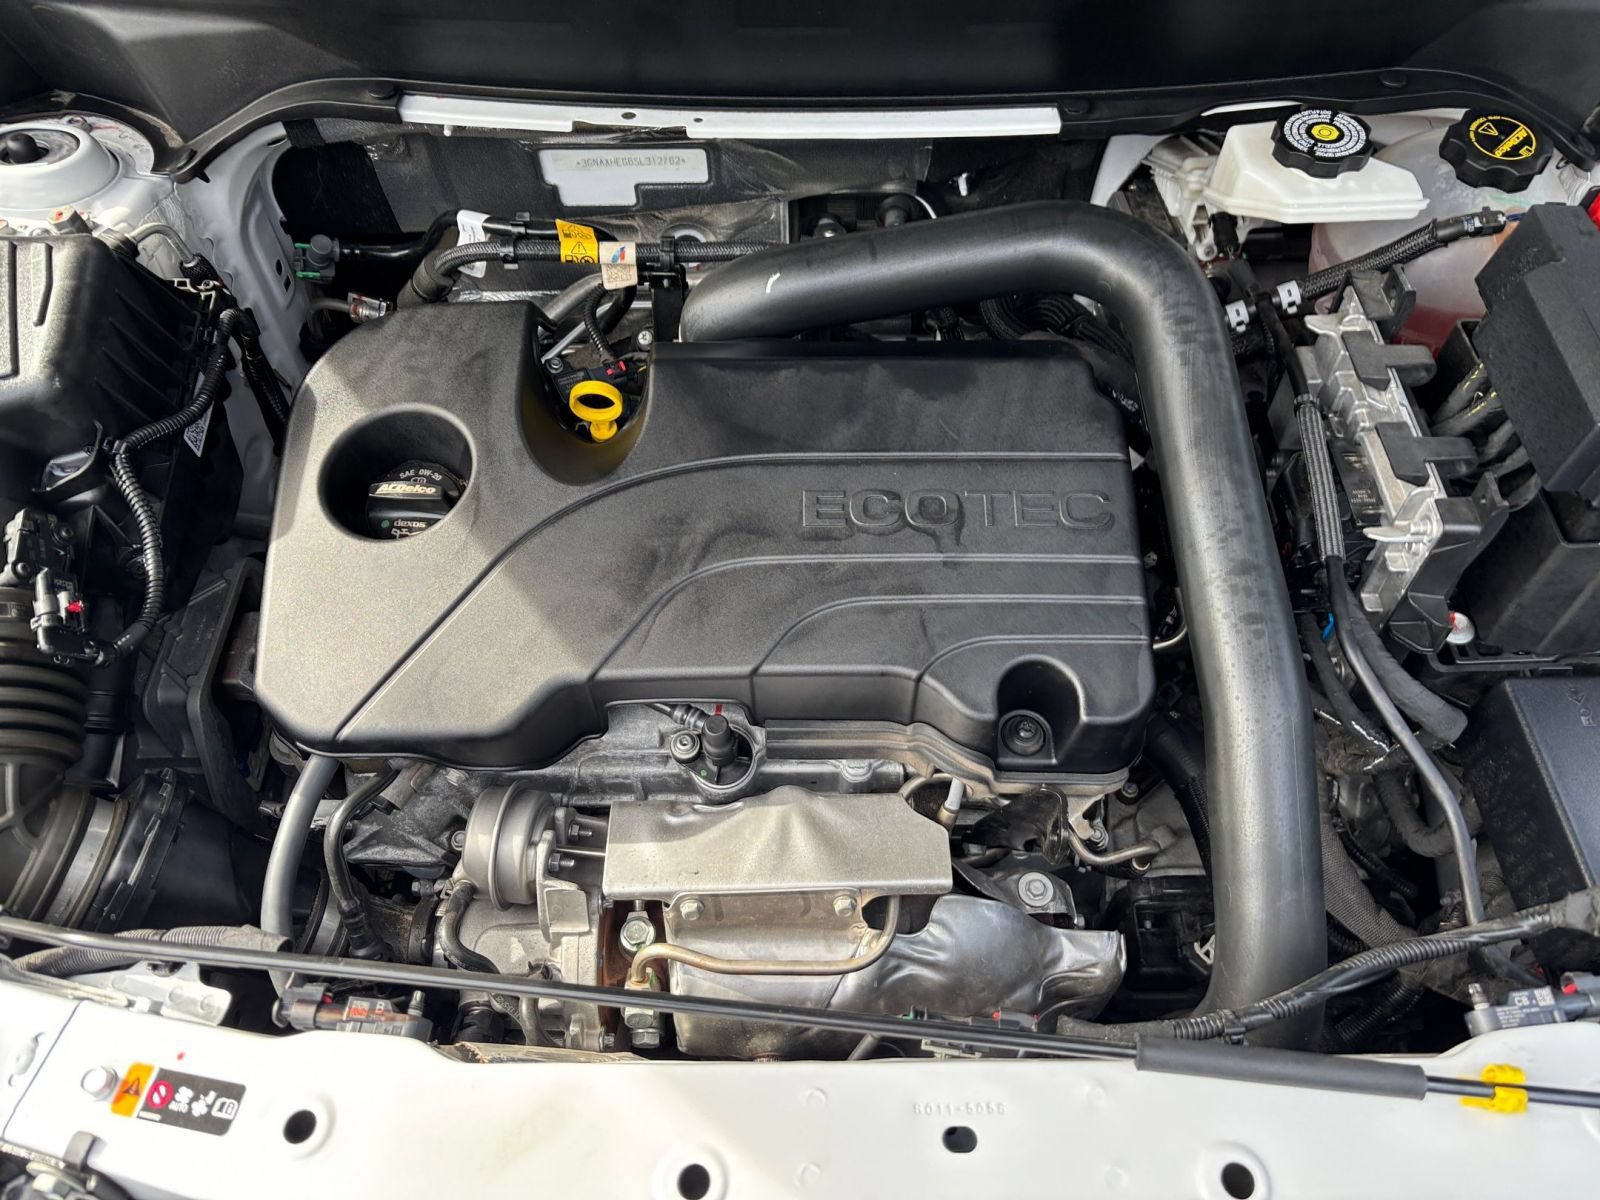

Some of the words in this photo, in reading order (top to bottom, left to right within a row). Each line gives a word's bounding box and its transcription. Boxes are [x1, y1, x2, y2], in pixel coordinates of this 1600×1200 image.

[399, 469, 415, 479] SAE
[419, 469, 443, 481] 0W-20
[375, 483, 436, 494] ACDelco
[802, 488, 1114, 530] ECOTEC
[393, 519, 426, 528] dexos
[169, 1101, 188, 1114] AUTO
